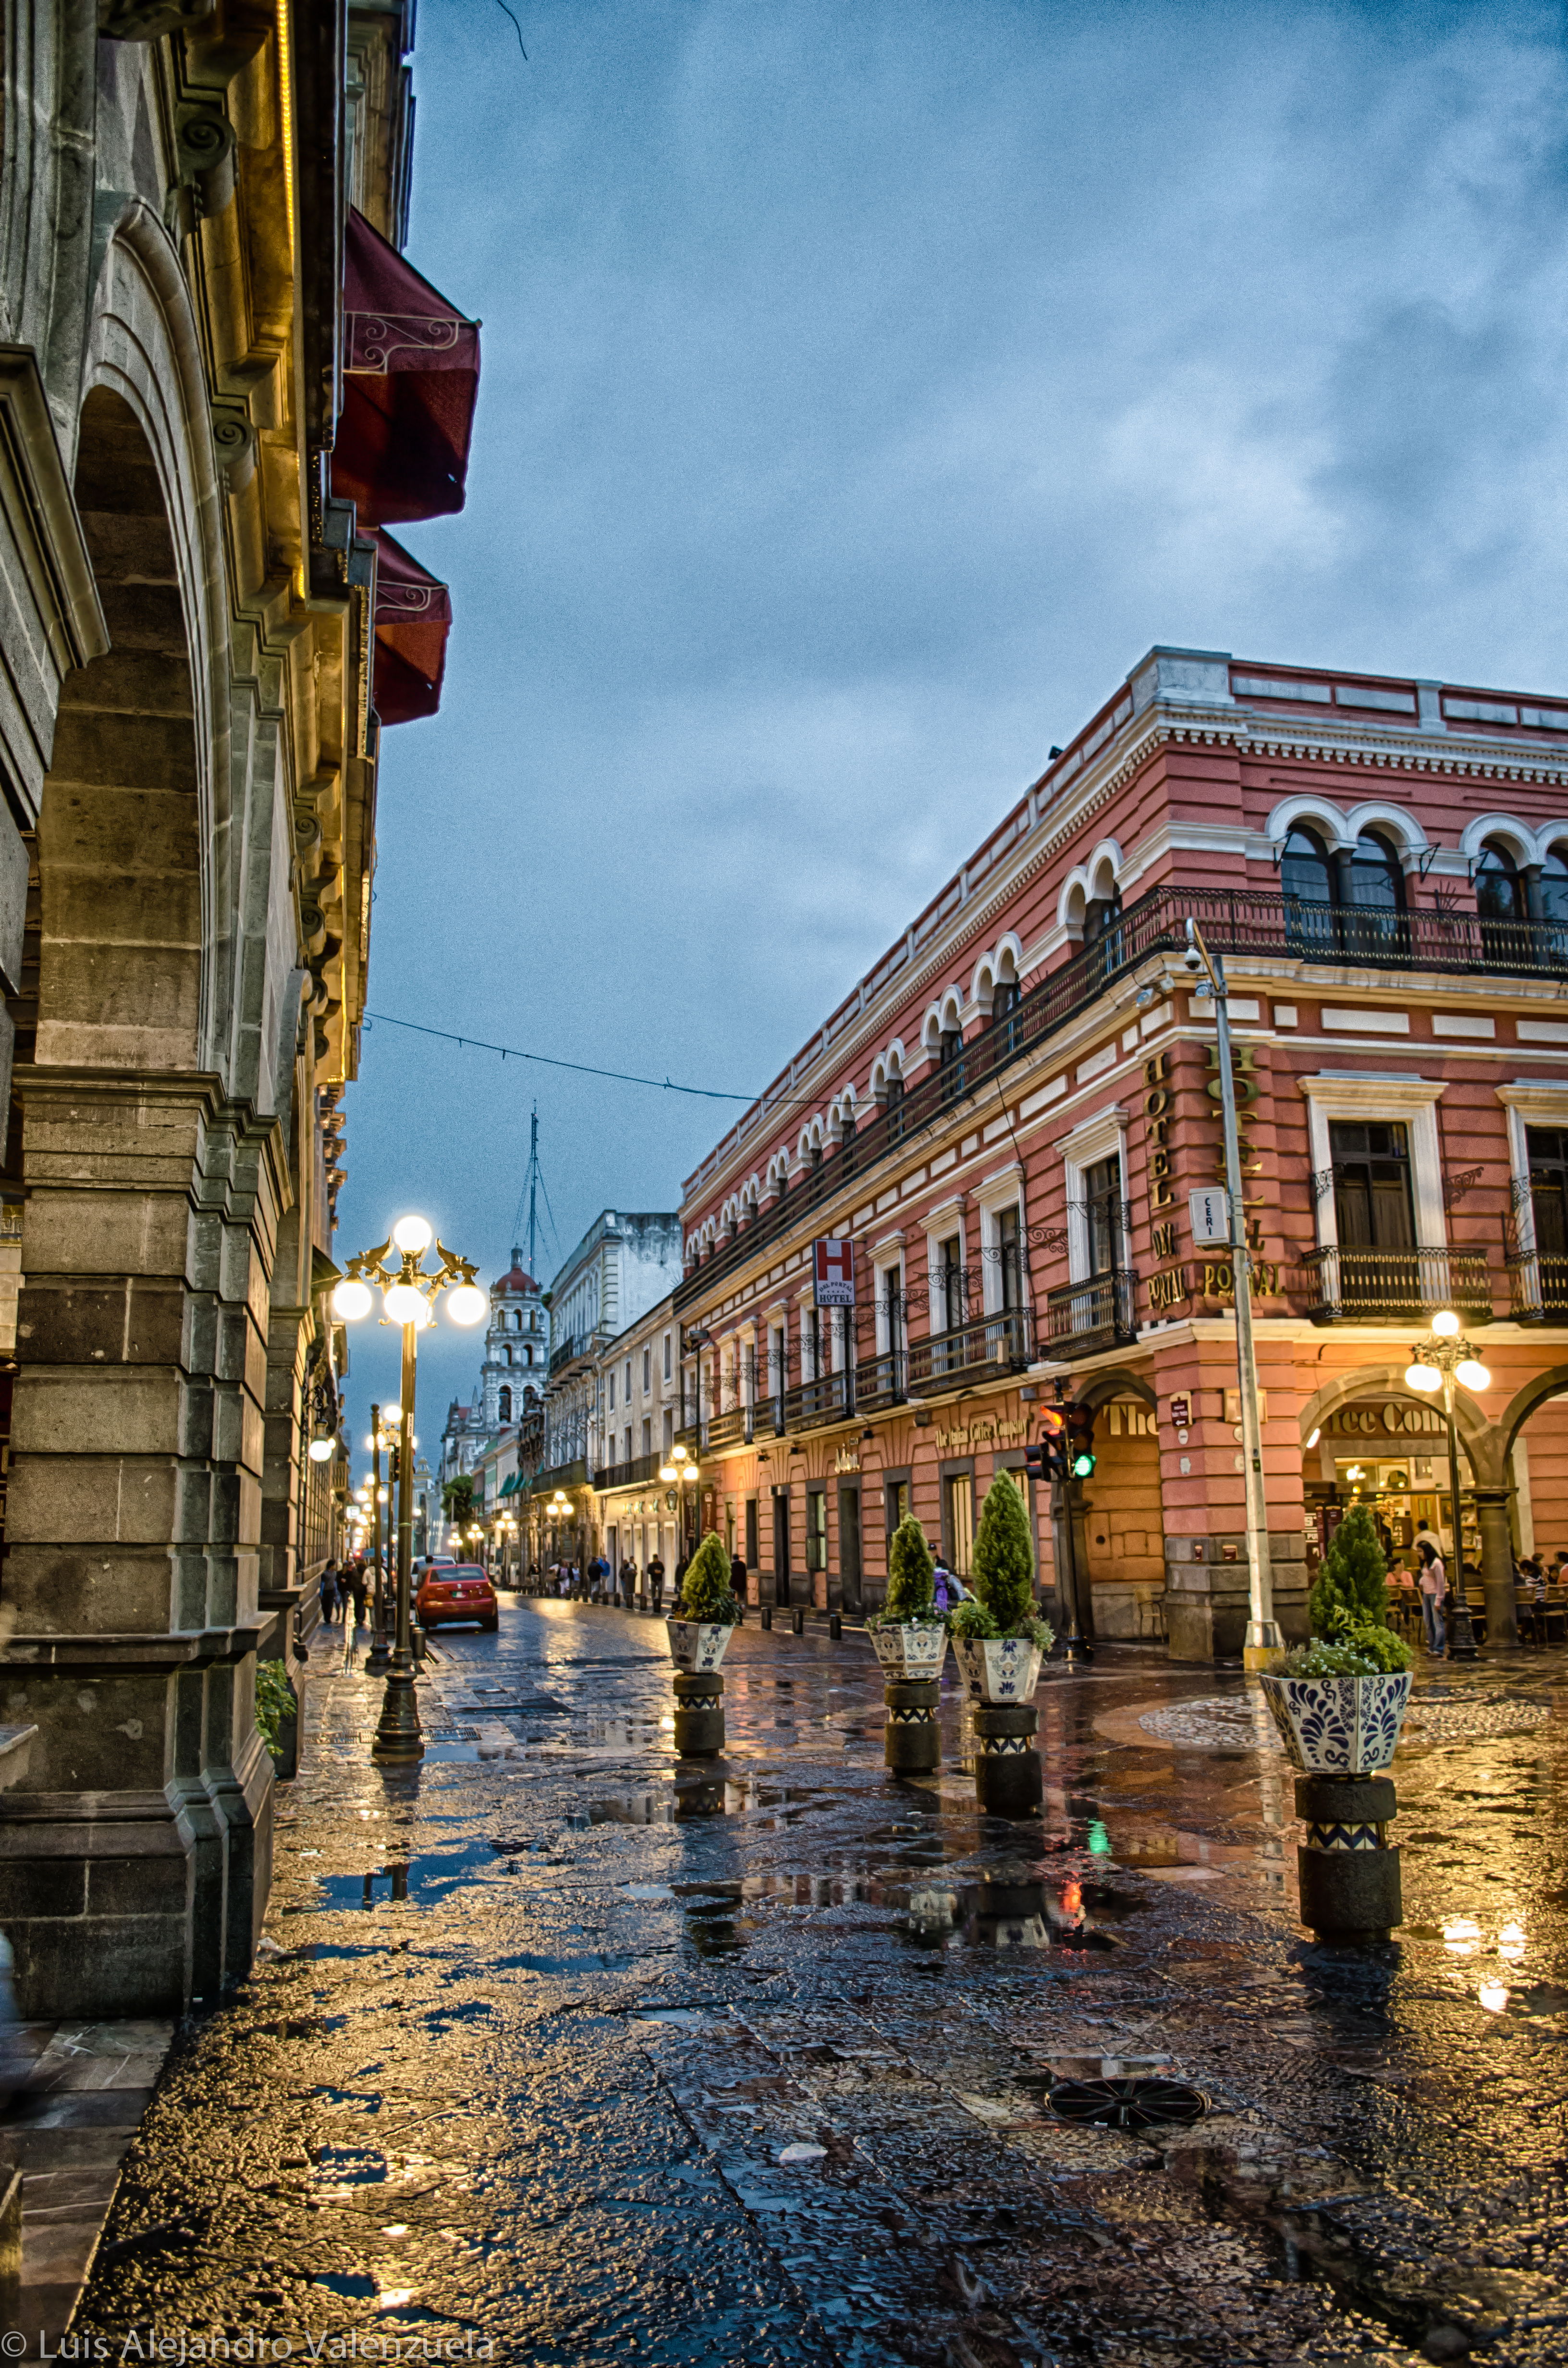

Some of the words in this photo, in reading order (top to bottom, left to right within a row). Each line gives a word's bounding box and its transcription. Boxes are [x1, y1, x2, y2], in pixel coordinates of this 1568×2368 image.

[1142, 1052, 1175, 1210] HOTEL
[1204, 1197, 1213, 1235] CERI
[817, 1241, 852, 1281] H
[819, 1283, 830, 1293] DEL
[831, 1282, 853, 1293] PORTAL
[819, 1295, 852, 1303] HOTEL
[1146, 1268, 1185, 1310] PORTAL
[970, 1421, 992, 1442] Coffee
[993, 1418, 1027, 1442] Company
